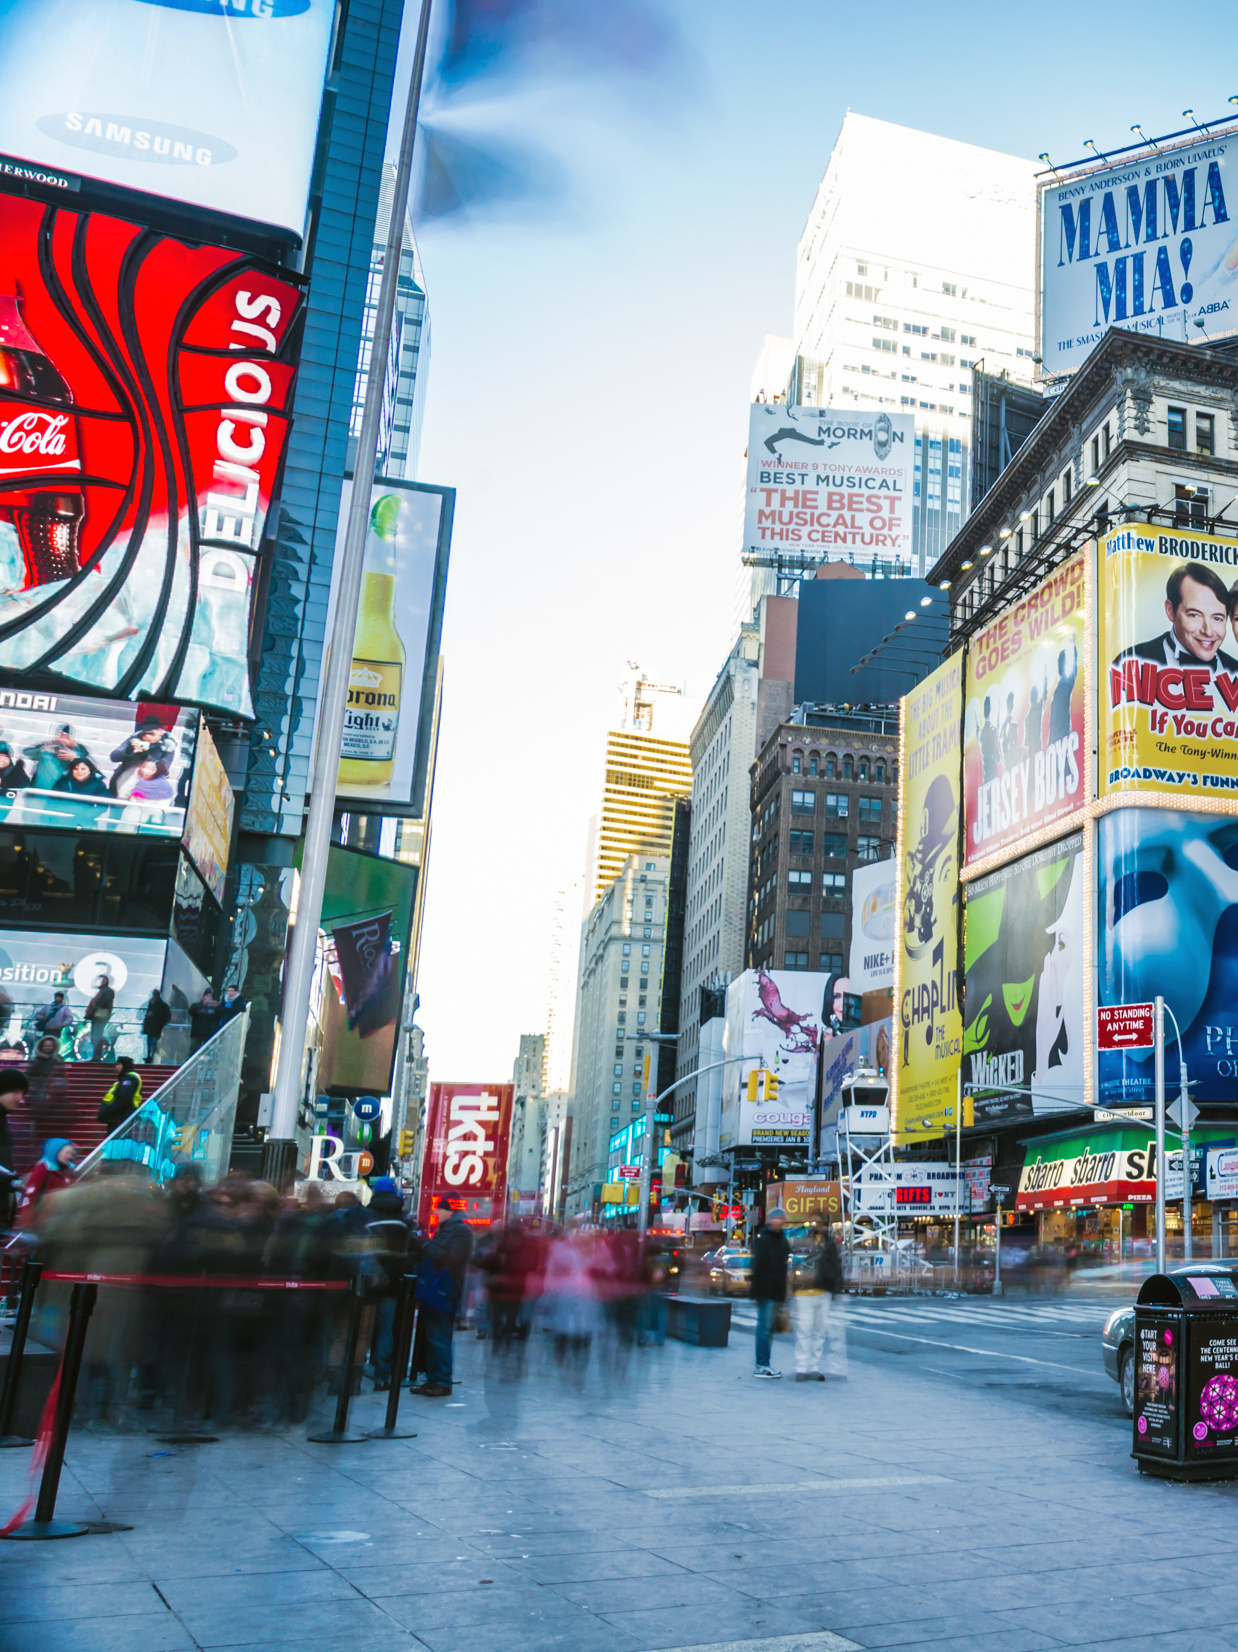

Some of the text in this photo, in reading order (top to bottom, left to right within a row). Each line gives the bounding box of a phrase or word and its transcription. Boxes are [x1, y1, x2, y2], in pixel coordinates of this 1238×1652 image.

[64, 112, 213, 166] SAMSUNG
[1058, 185, 1087, 202] BENNY
[1088, 170, 1141, 192] ANDERSSON
[1156, 156, 1186, 174] BJÖRN
[1057, 160, 1230, 267] MAMMA
[1093, 237, 1194, 327] MIA!
[760, 459, 903, 477] WINNER TONY AWARDS
[760, 471, 903, 492] BEST MUSICAL
[827, 491, 902, 515] BEST
[757, 509, 902, 532] MUSICAL OF
[757, 526, 803, 542] THIS
[1013, 557, 1084, 628] CROWD
[975, 631, 1023, 680] GOES
[1110, 659, 1214, 711] NICE
[1151, 709, 1169, 733] If
[1172, 714, 1208, 738] You
[1156, 741, 1177, 754] The
[908, 743, 930, 782] LITTLE
[1109, 767, 1198, 786] BROADWAY'S
[973, 760, 1030, 845] JERSEY
[1034, 731, 1080, 809] BOYS
[863, 952, 890, 970] NIKE+
[1100, 1008, 1150, 1021] NO STANDING
[1106, 1020, 1144, 1031] ANYTIME
[860, 1110, 877, 1119] NYPD
[444, 1092, 500, 1186] tkts
[1023, 1157, 1064, 1193] sbarro
[1070, 1147, 1117, 1186] sbarro
[896, 1187, 930, 1202] GIFTS
[785, 1196, 838, 1213] GIFTS
[1141, 1329, 1157, 1340] START
[1209, 1339, 1225, 1347] COME
[1142, 1341, 1157, 1351] YOUR
[1143, 1352, 1156, 1362] VISIT
[1200, 1354, 1213, 1362] NEW
[1214, 1353, 1234, 1361] YEAR'S
[1215, 1361, 1230, 1369] BALL!
[1142, 1364, 1156, 1375] HERE
